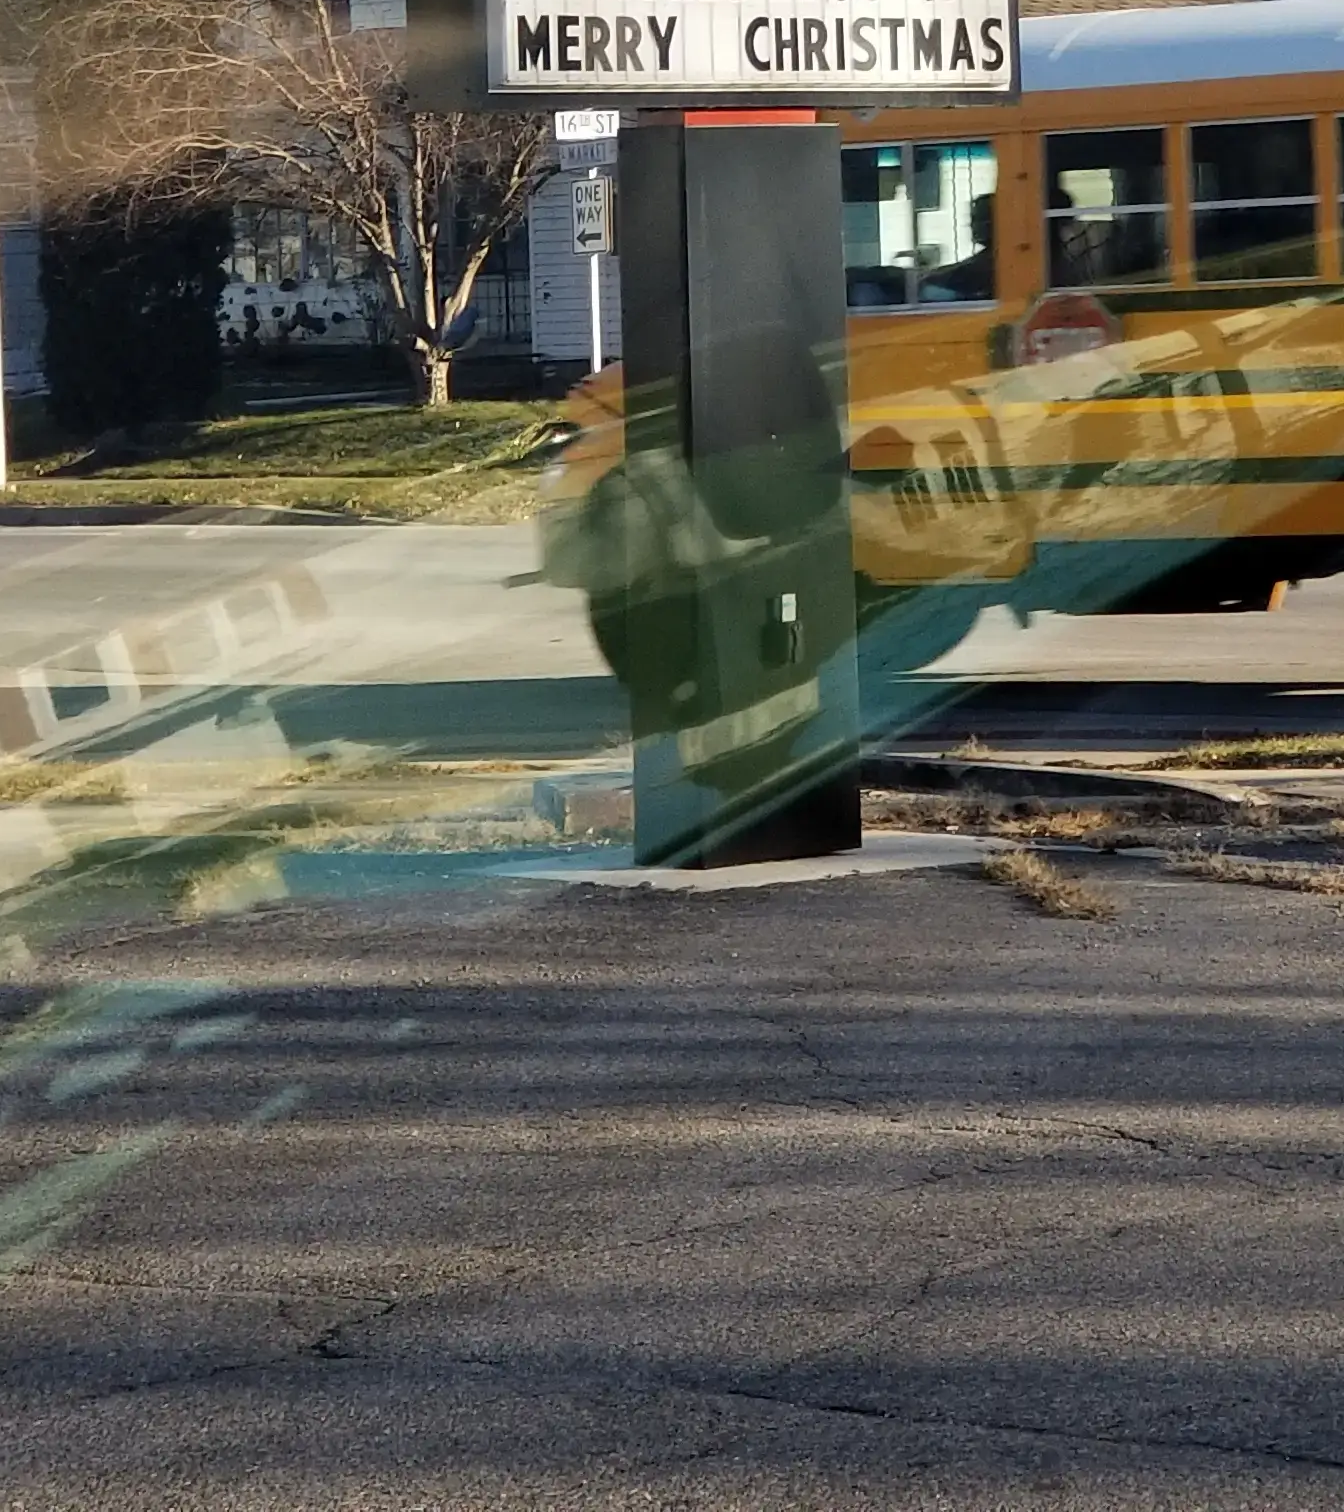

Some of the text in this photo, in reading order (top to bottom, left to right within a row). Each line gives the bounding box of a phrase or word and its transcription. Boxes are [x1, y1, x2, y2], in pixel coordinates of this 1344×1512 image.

[517, 14, 1004, 72] MERRY CHRISTMAS
[596, 114, 614, 133] ST
[576, 185, 601, 203] ONE
[576, 206, 602, 224] WAY
